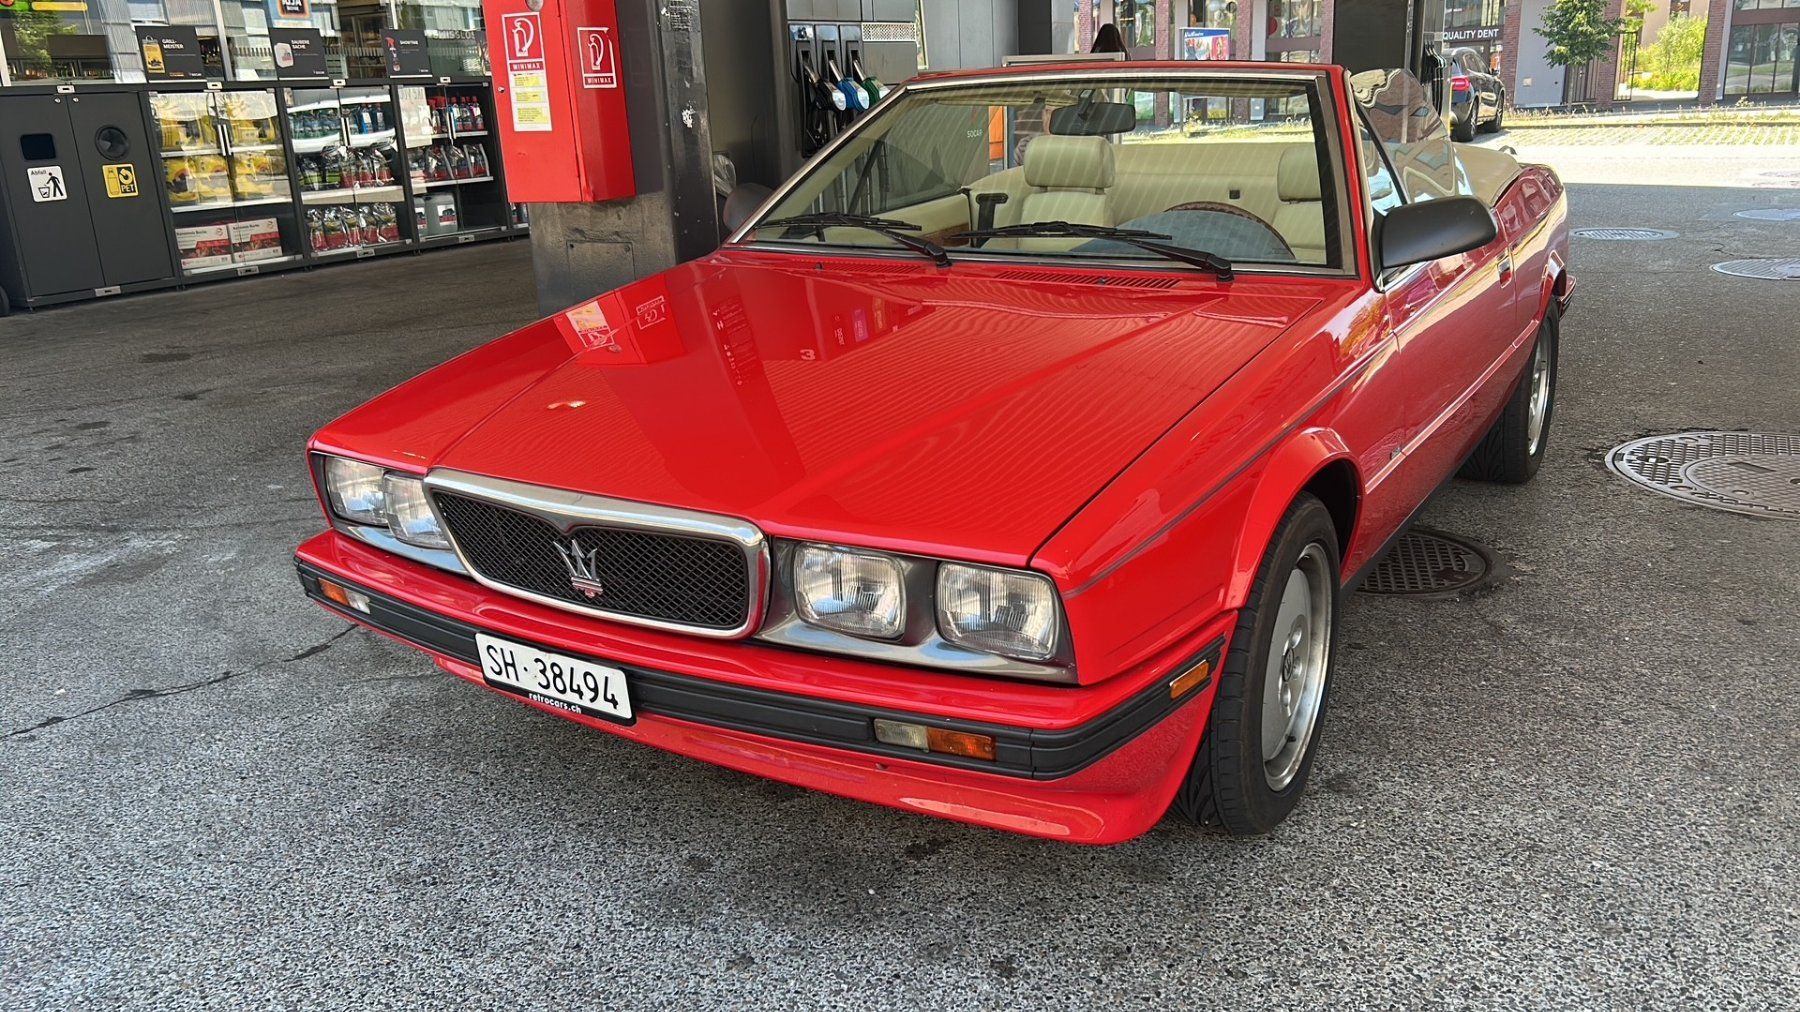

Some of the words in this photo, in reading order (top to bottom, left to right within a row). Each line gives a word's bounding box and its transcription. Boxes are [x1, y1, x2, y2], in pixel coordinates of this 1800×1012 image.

[1443, 31, 1476, 40] QUALITY
[1477, 29, 1499, 38] DENT
[513, 63, 541, 71] MINIMAX
[121, 184, 136, 193] PET
[529, 691, 582, 714] retrocars.ch
